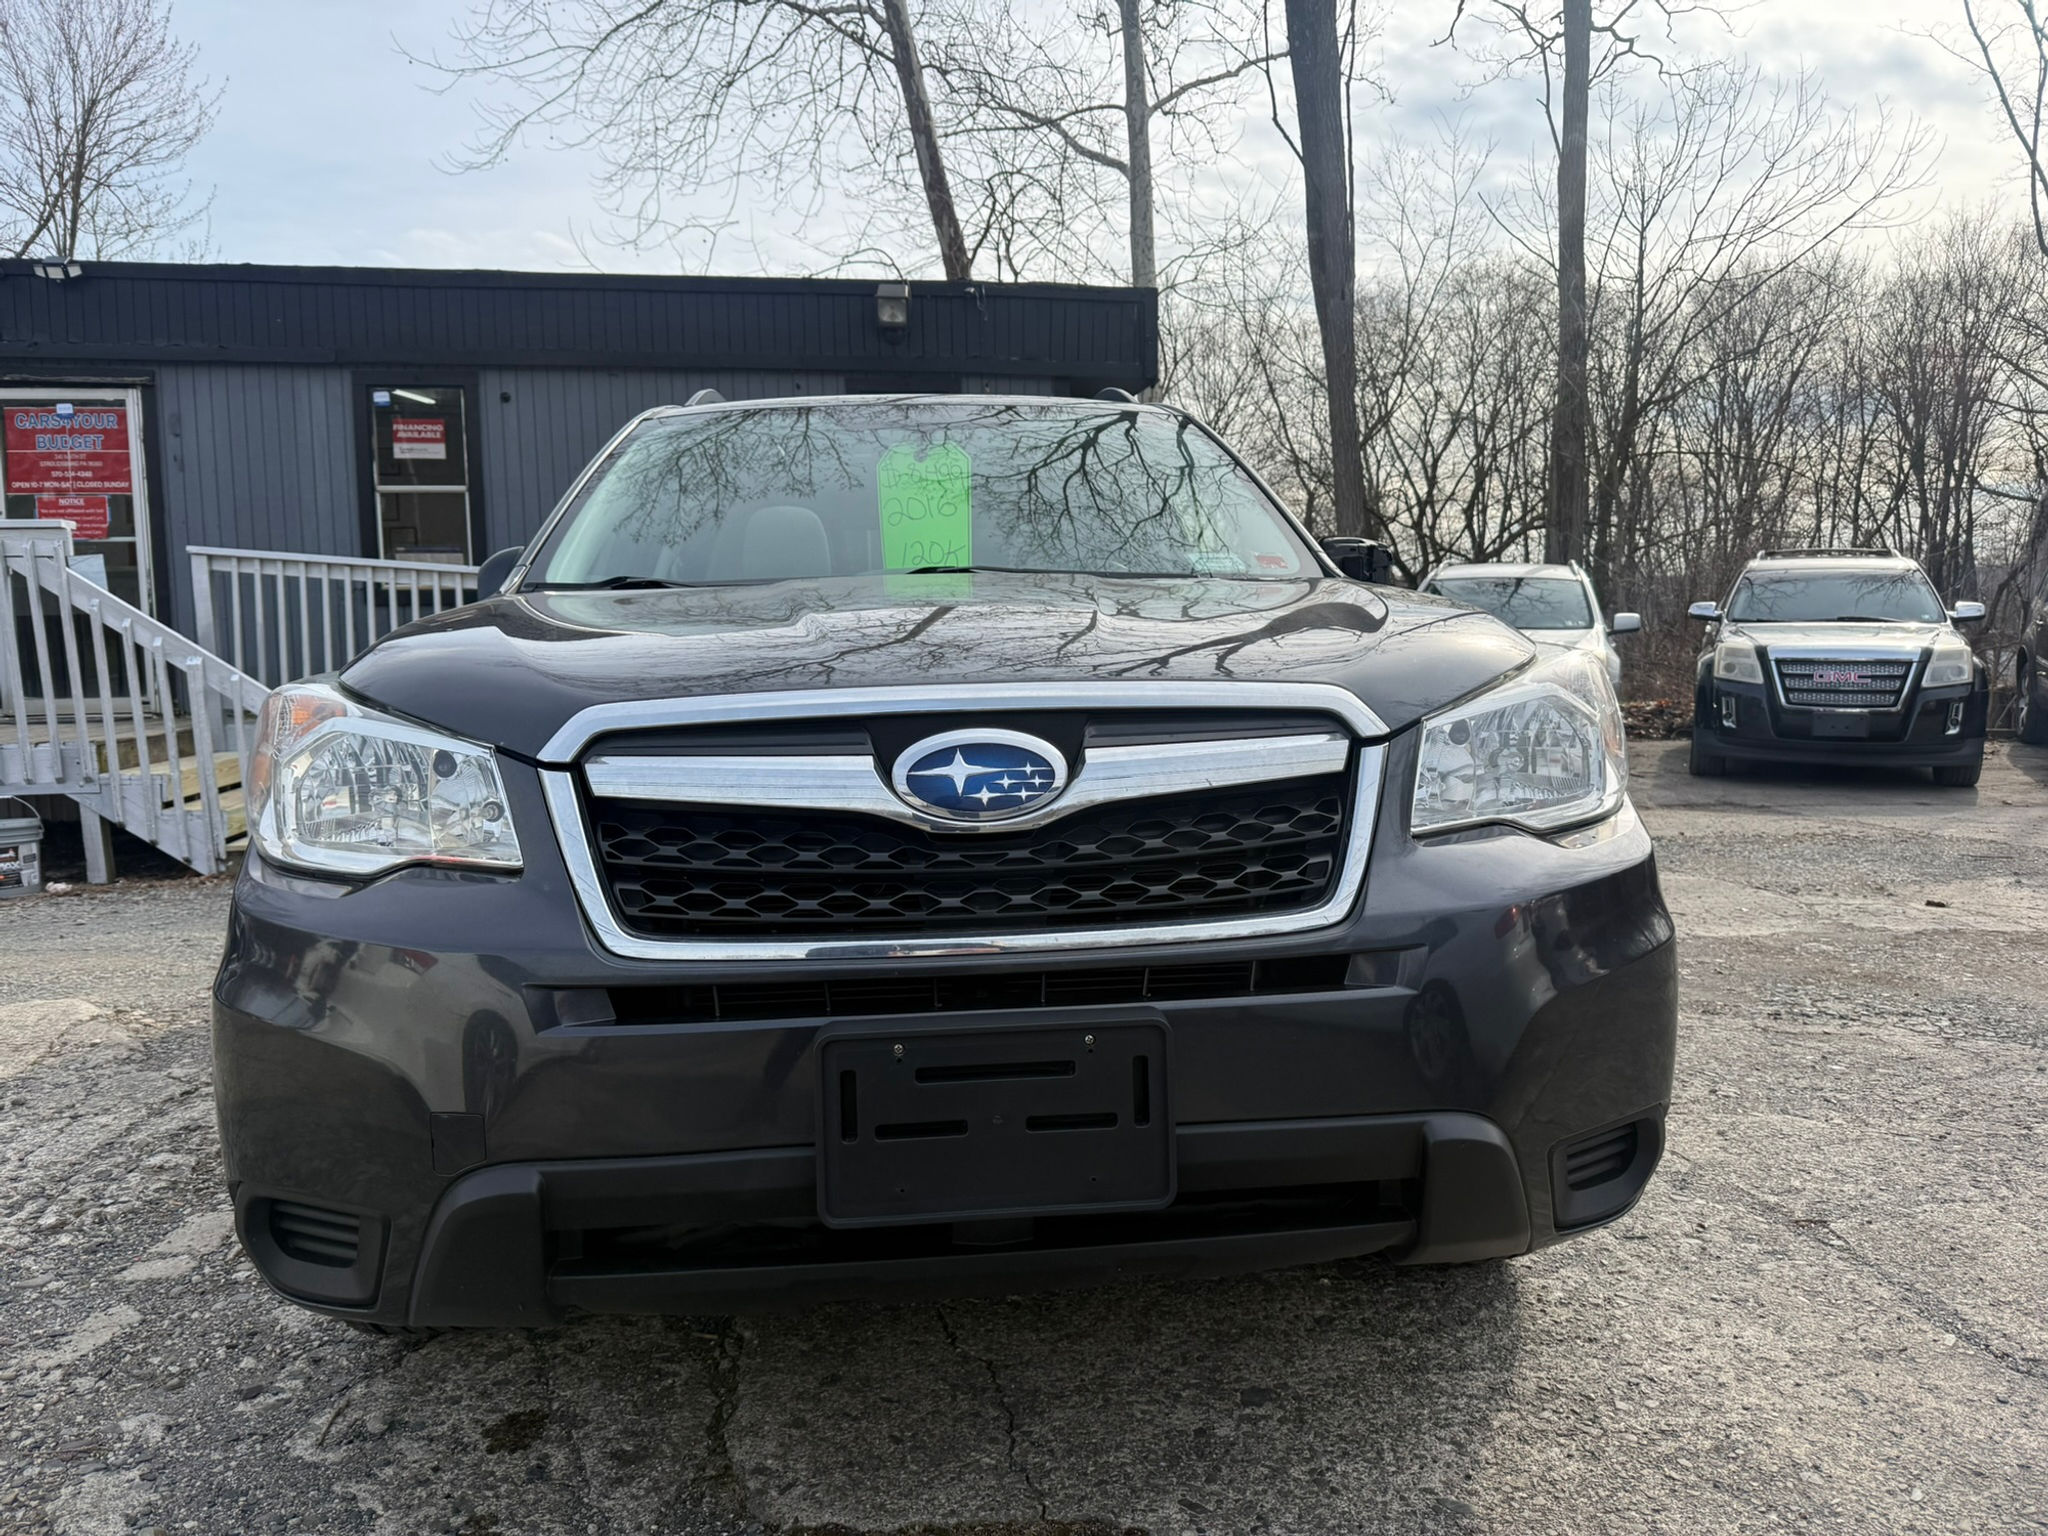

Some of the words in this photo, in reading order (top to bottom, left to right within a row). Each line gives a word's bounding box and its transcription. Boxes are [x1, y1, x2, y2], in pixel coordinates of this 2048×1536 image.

[36, 435, 104, 450] BUDGET
[59, 498, 84, 506] NOTICE
[884, 495, 958, 527] 2016
[903, 539, 966, 568] 120K
[1813, 671, 1872, 683] GMC
